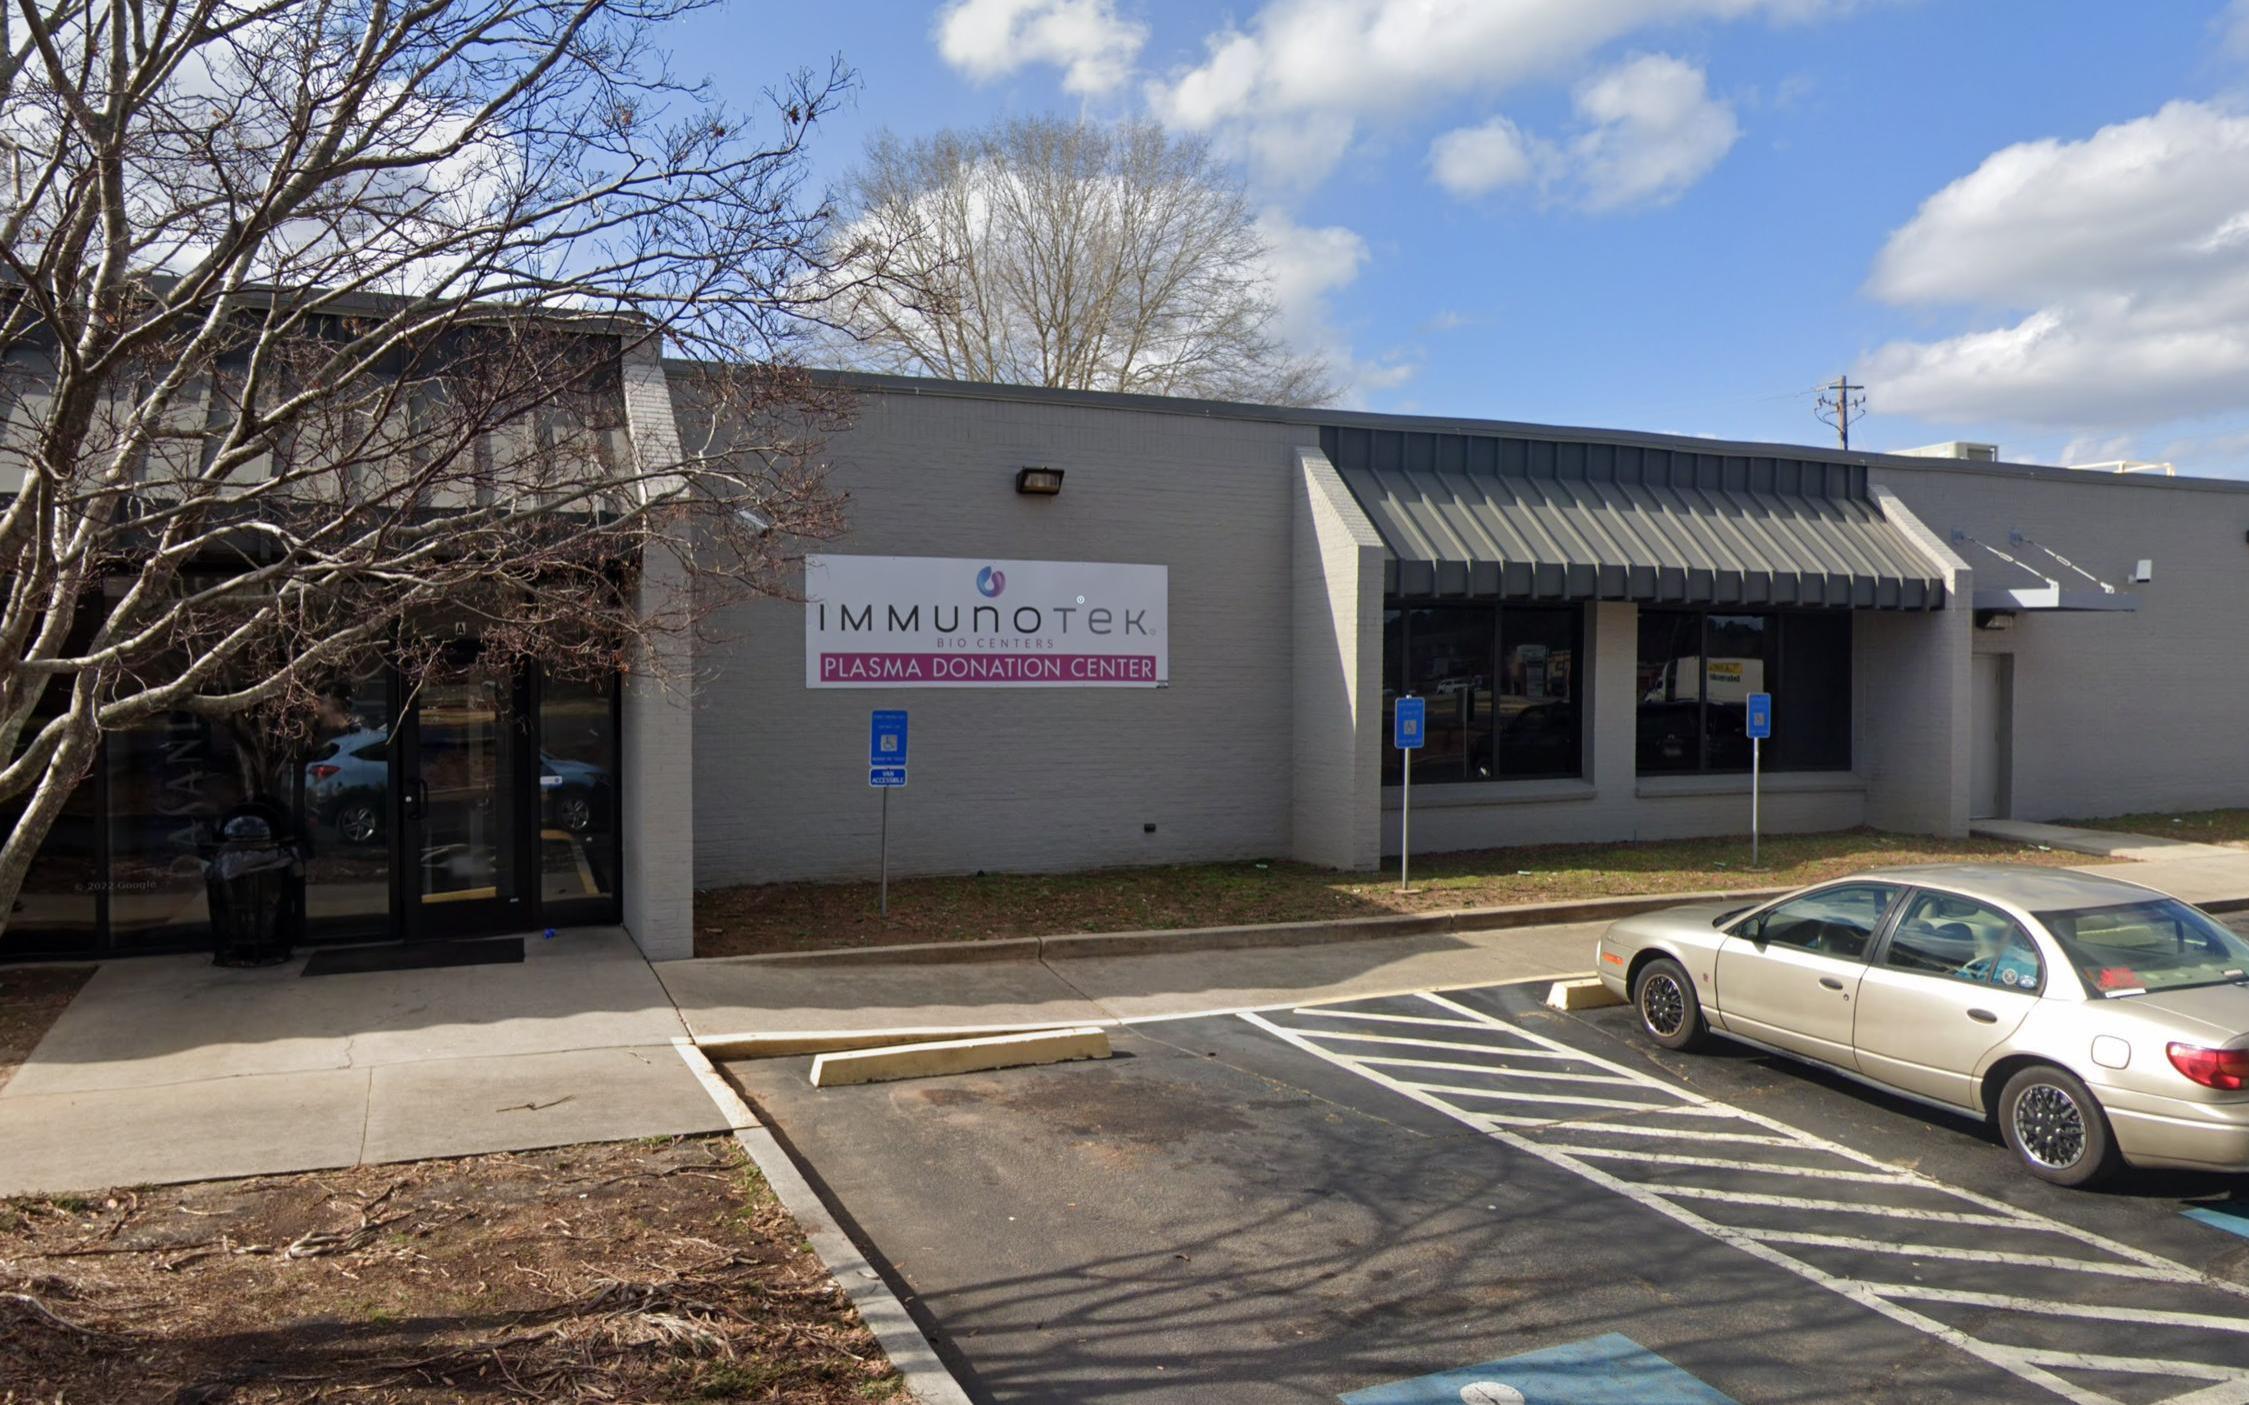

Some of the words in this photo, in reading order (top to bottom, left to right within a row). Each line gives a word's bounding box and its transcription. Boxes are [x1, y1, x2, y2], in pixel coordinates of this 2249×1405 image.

[937, 637, 967, 649] BIO
[976, 638, 1054, 650] CENTERS
[824, 657, 922, 678] PLASMA
[932, 657, 1060, 678] DONATION
[1070, 658, 1153, 678] CENTER
